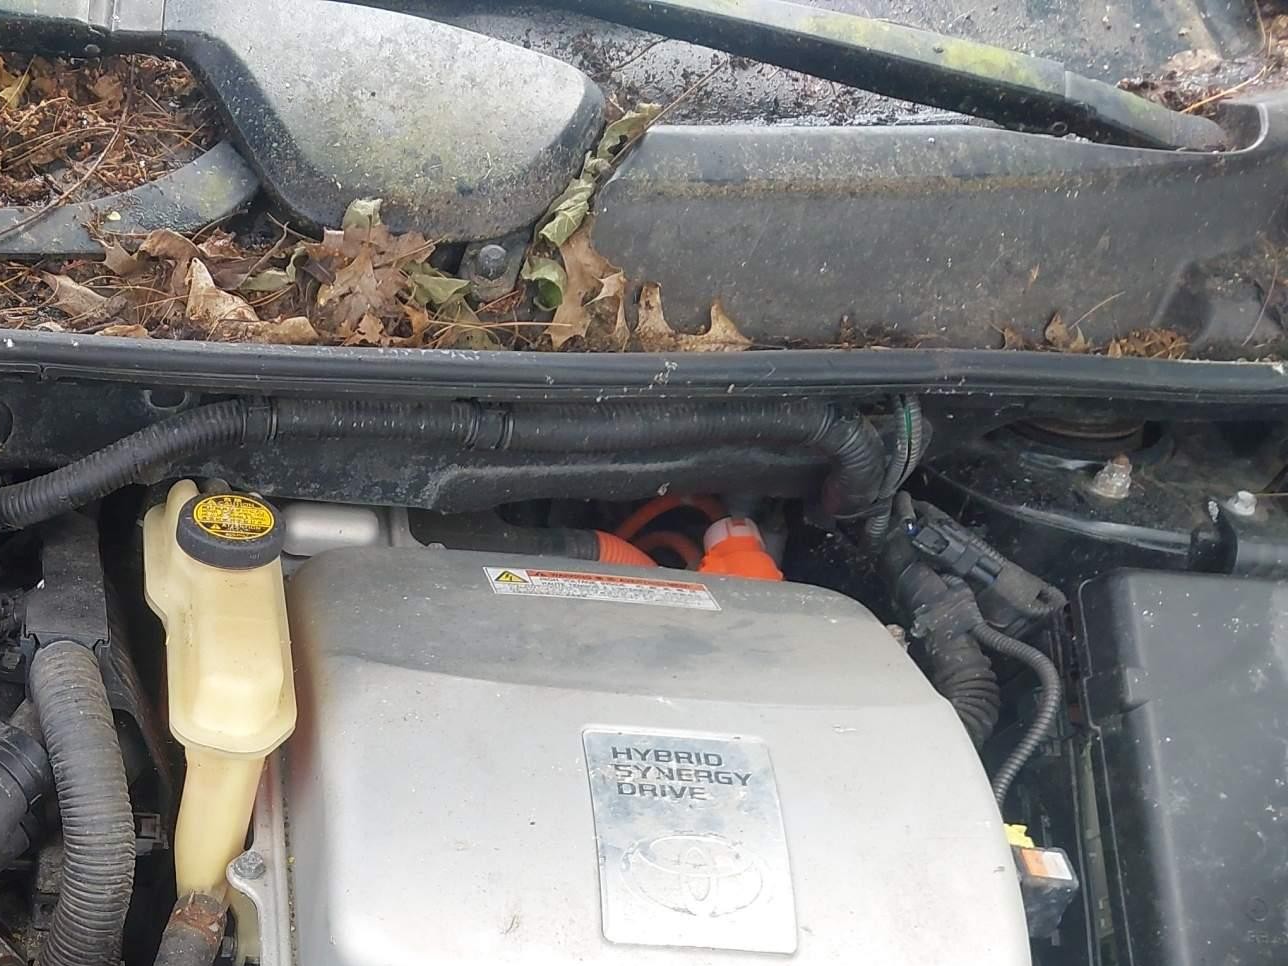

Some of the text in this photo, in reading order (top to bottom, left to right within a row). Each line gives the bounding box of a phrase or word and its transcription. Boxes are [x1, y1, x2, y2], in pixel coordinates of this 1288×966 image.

[612, 747, 722, 766] HYBRID
[614, 764, 752, 786] SYNERGY
[617, 782, 707, 800] DRIVE
